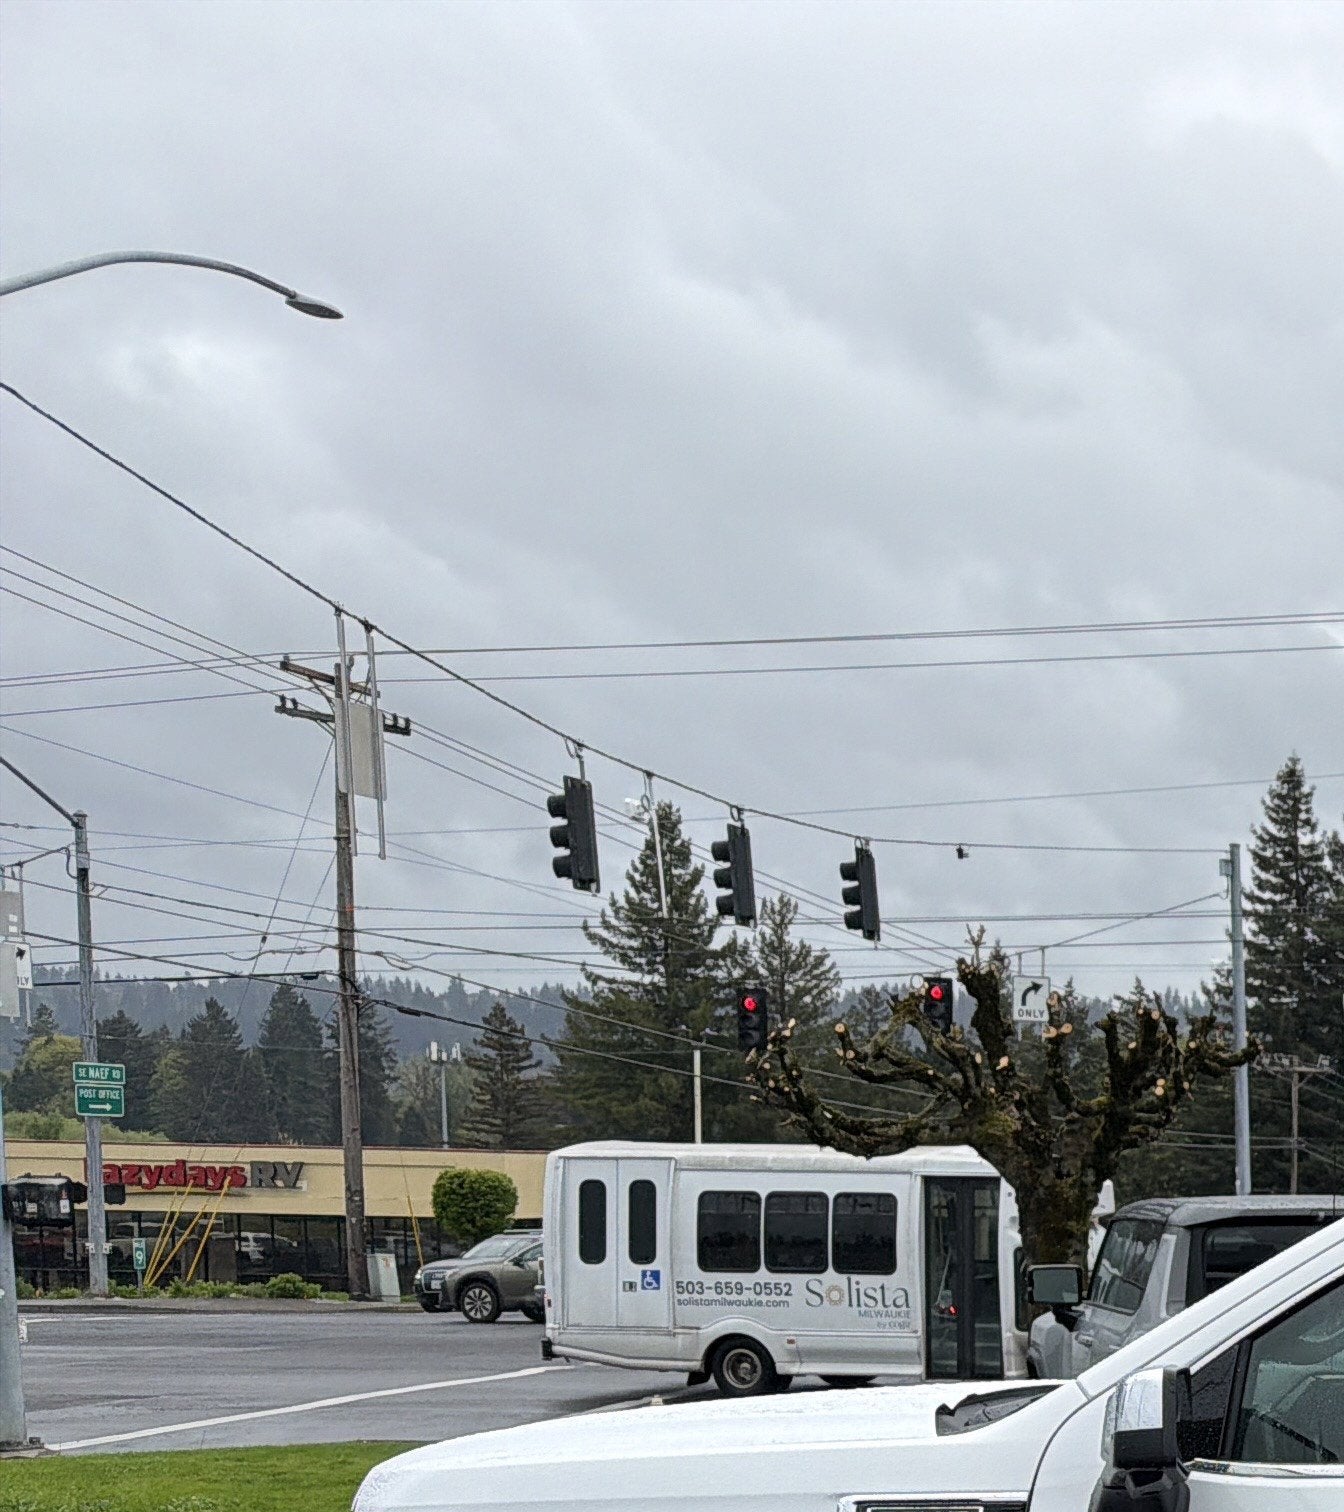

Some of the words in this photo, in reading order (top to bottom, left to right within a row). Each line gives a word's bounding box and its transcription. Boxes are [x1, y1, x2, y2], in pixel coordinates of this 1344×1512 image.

[1017, 1008, 1045, 1019] ONLY
[78, 1067, 87, 1078] SE
[88, 1066, 109, 1080] NAEF
[79, 1088, 96, 1099] POST
[98, 1089, 120, 1100] OFFICE
[84, 1158, 248, 1191] azydays
[250, 1161, 305, 1188] RV
[135, 1250, 144, 1265] 9
[675, 1280, 793, 1296] 503-659-0552
[805, 1276, 911, 1309] Solista
[676, 1297, 790, 1308] solistamilwaukie.com
[858, 1310, 911, 1319] MILWAUKIE
